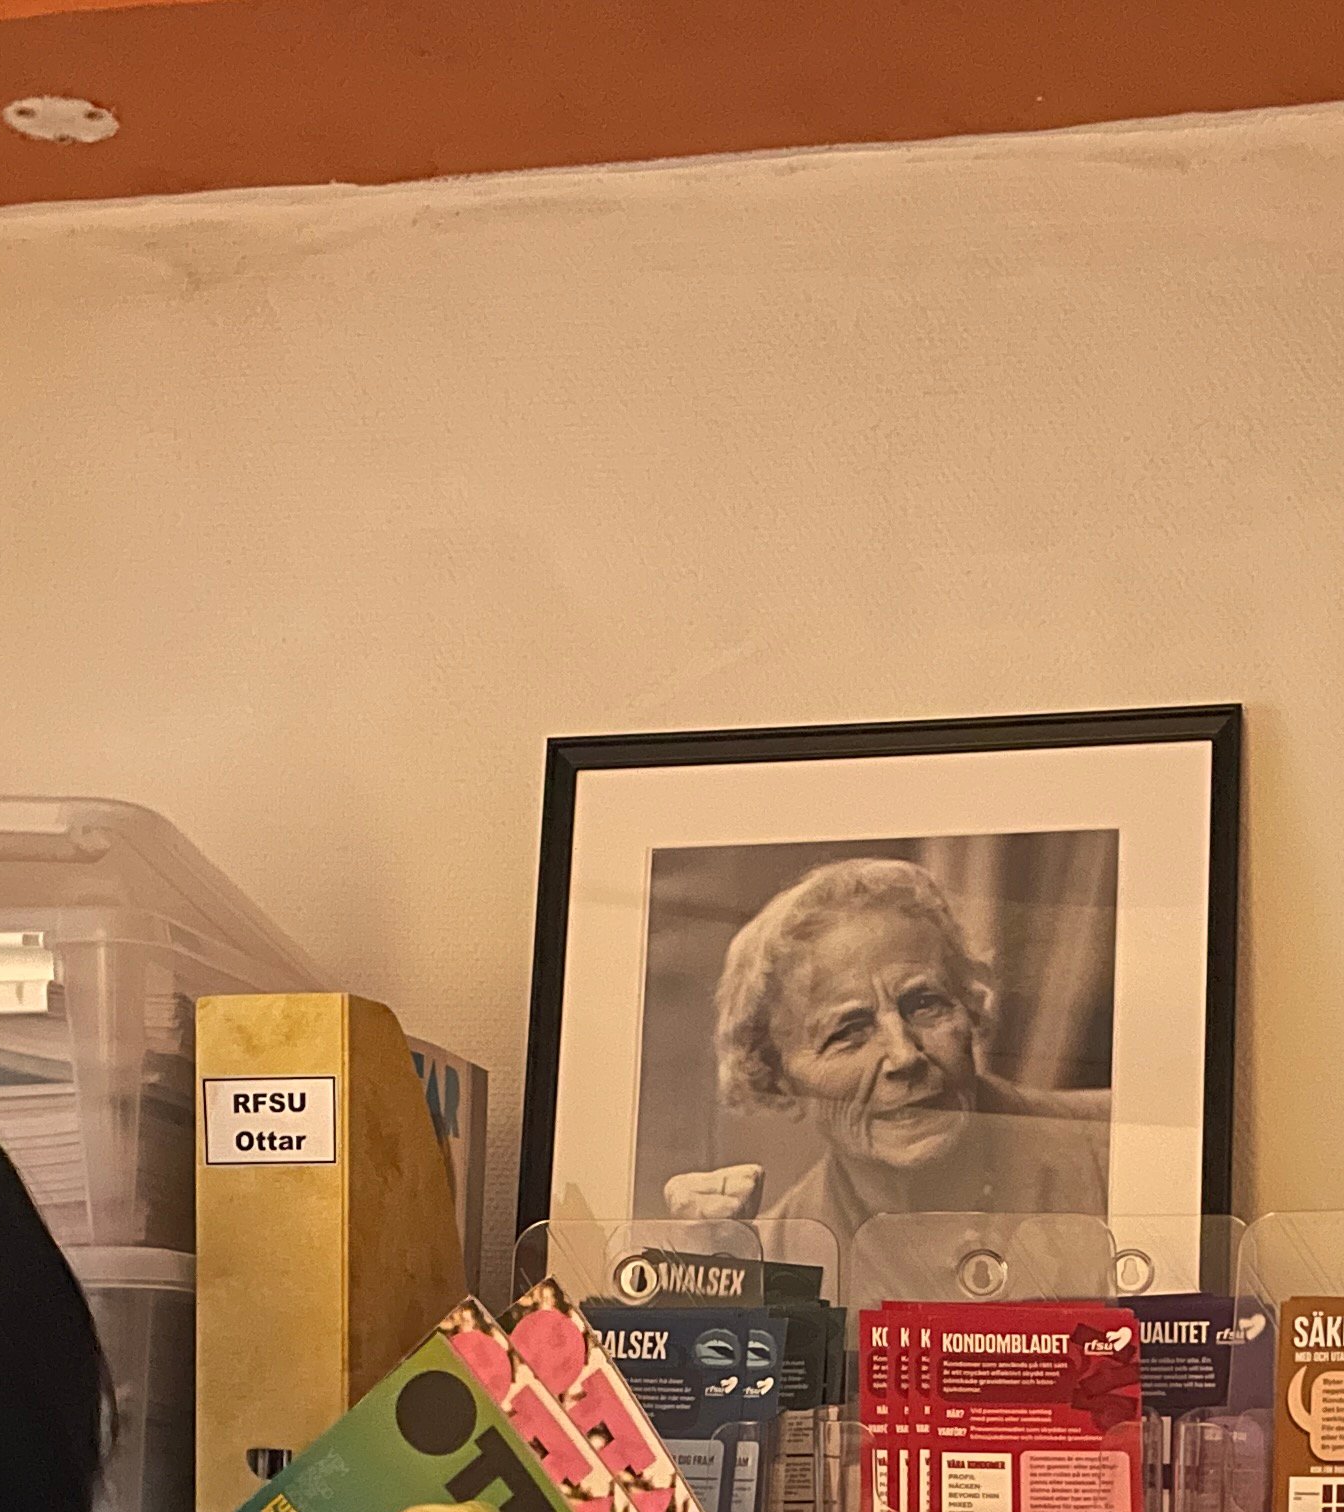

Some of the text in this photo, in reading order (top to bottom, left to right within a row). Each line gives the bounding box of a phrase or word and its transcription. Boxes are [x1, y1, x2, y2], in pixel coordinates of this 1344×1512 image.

[233, 1092, 306, 1113] RFSU
[235, 1131, 306, 1151] Ottar
[658, 1262, 745, 1296] ANALSEX
[942, 1333, 1069, 1354] KONDOMBLADET
[1084, 1339, 1114, 1351] rfsu
[1140, 1321, 1210, 1344] UALITET
[594, 1330, 669, 1360] ALSEX
